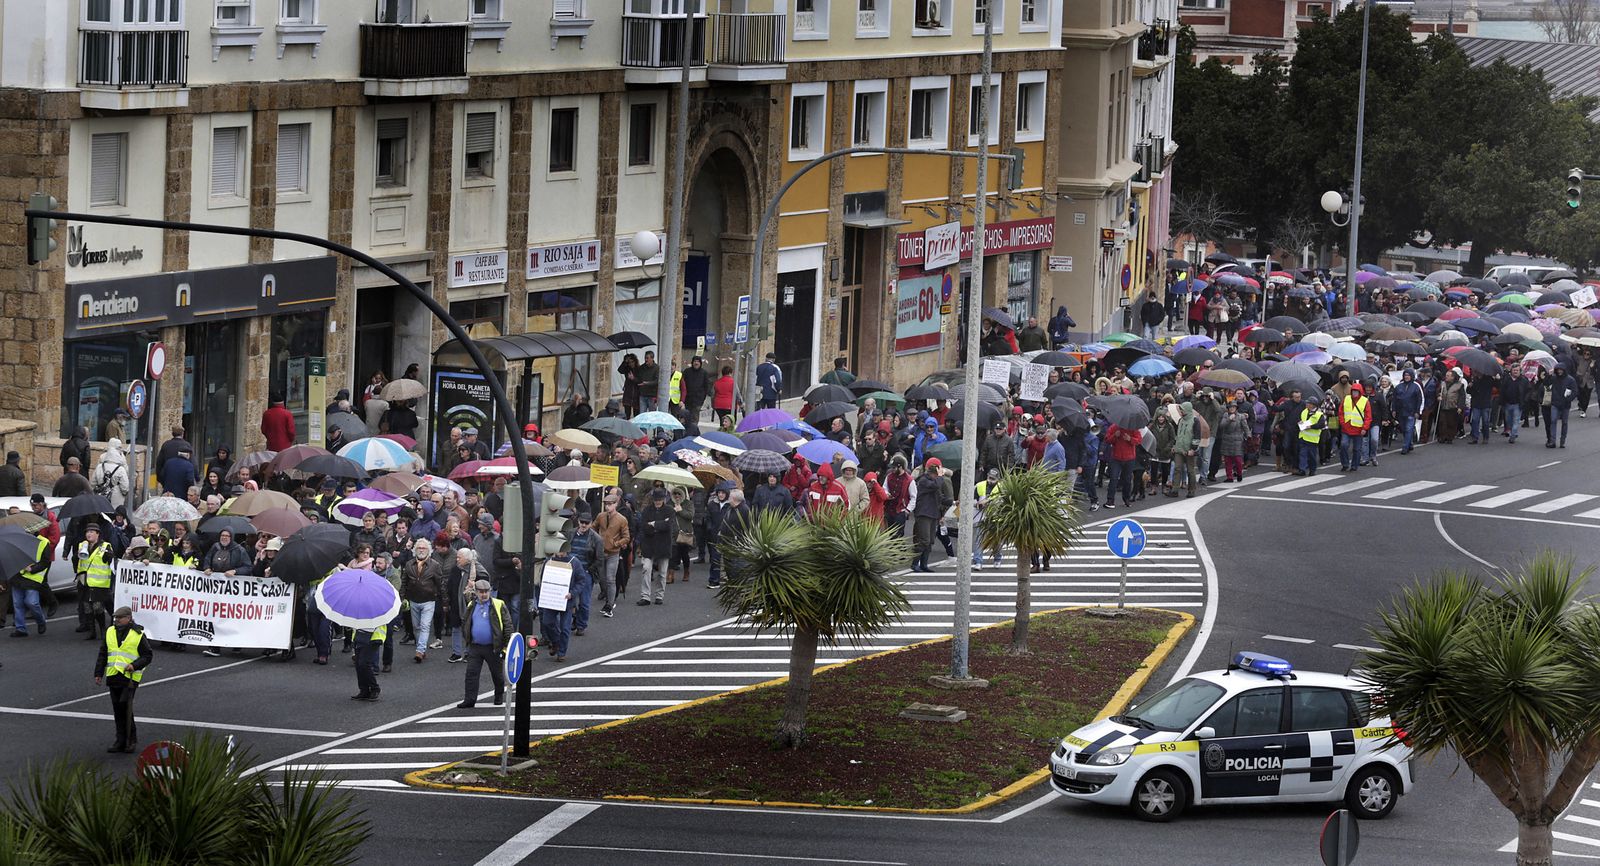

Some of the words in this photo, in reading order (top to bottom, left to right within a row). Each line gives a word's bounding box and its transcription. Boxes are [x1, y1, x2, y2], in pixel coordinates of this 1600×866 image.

[900, 234, 924, 259] TÓNER
[960, 229, 1003, 252] CARCHOS
[1010, 224, 1053, 247] IMPRESORAS
[927, 231, 959, 265] prink
[488, 255, 499, 266] BAR
[544, 248, 561, 263] RIO
[563, 245, 583, 263] SAJA
[564, 263, 583, 272] CASERAS
[469, 269, 504, 282] RESTAURANTE
[899, 296, 918, 311] AHORRAS
[898, 311, 911, 324] HASTA
[1008, 302, 1029, 323] PAPEL
[468, 384, 491, 392] PLANETA
[120, 568, 149, 587] MAREA
[151, 571, 163, 587] DE
[164, 573, 239, 596] PENSIONISTAS
[243, 581, 258, 597] DE
[261, 581, 291, 598] CÁDIZ
[141, 593, 168, 611] LUCHA
[171, 597, 194, 615] POR
[198, 600, 210, 617] TU
[212, 601, 262, 620] PENSIÓN
[178, 618, 215, 635] MAREA
[1160, 743, 1176, 752] R-9
[1225, 757, 1281, 771] POLICIA
